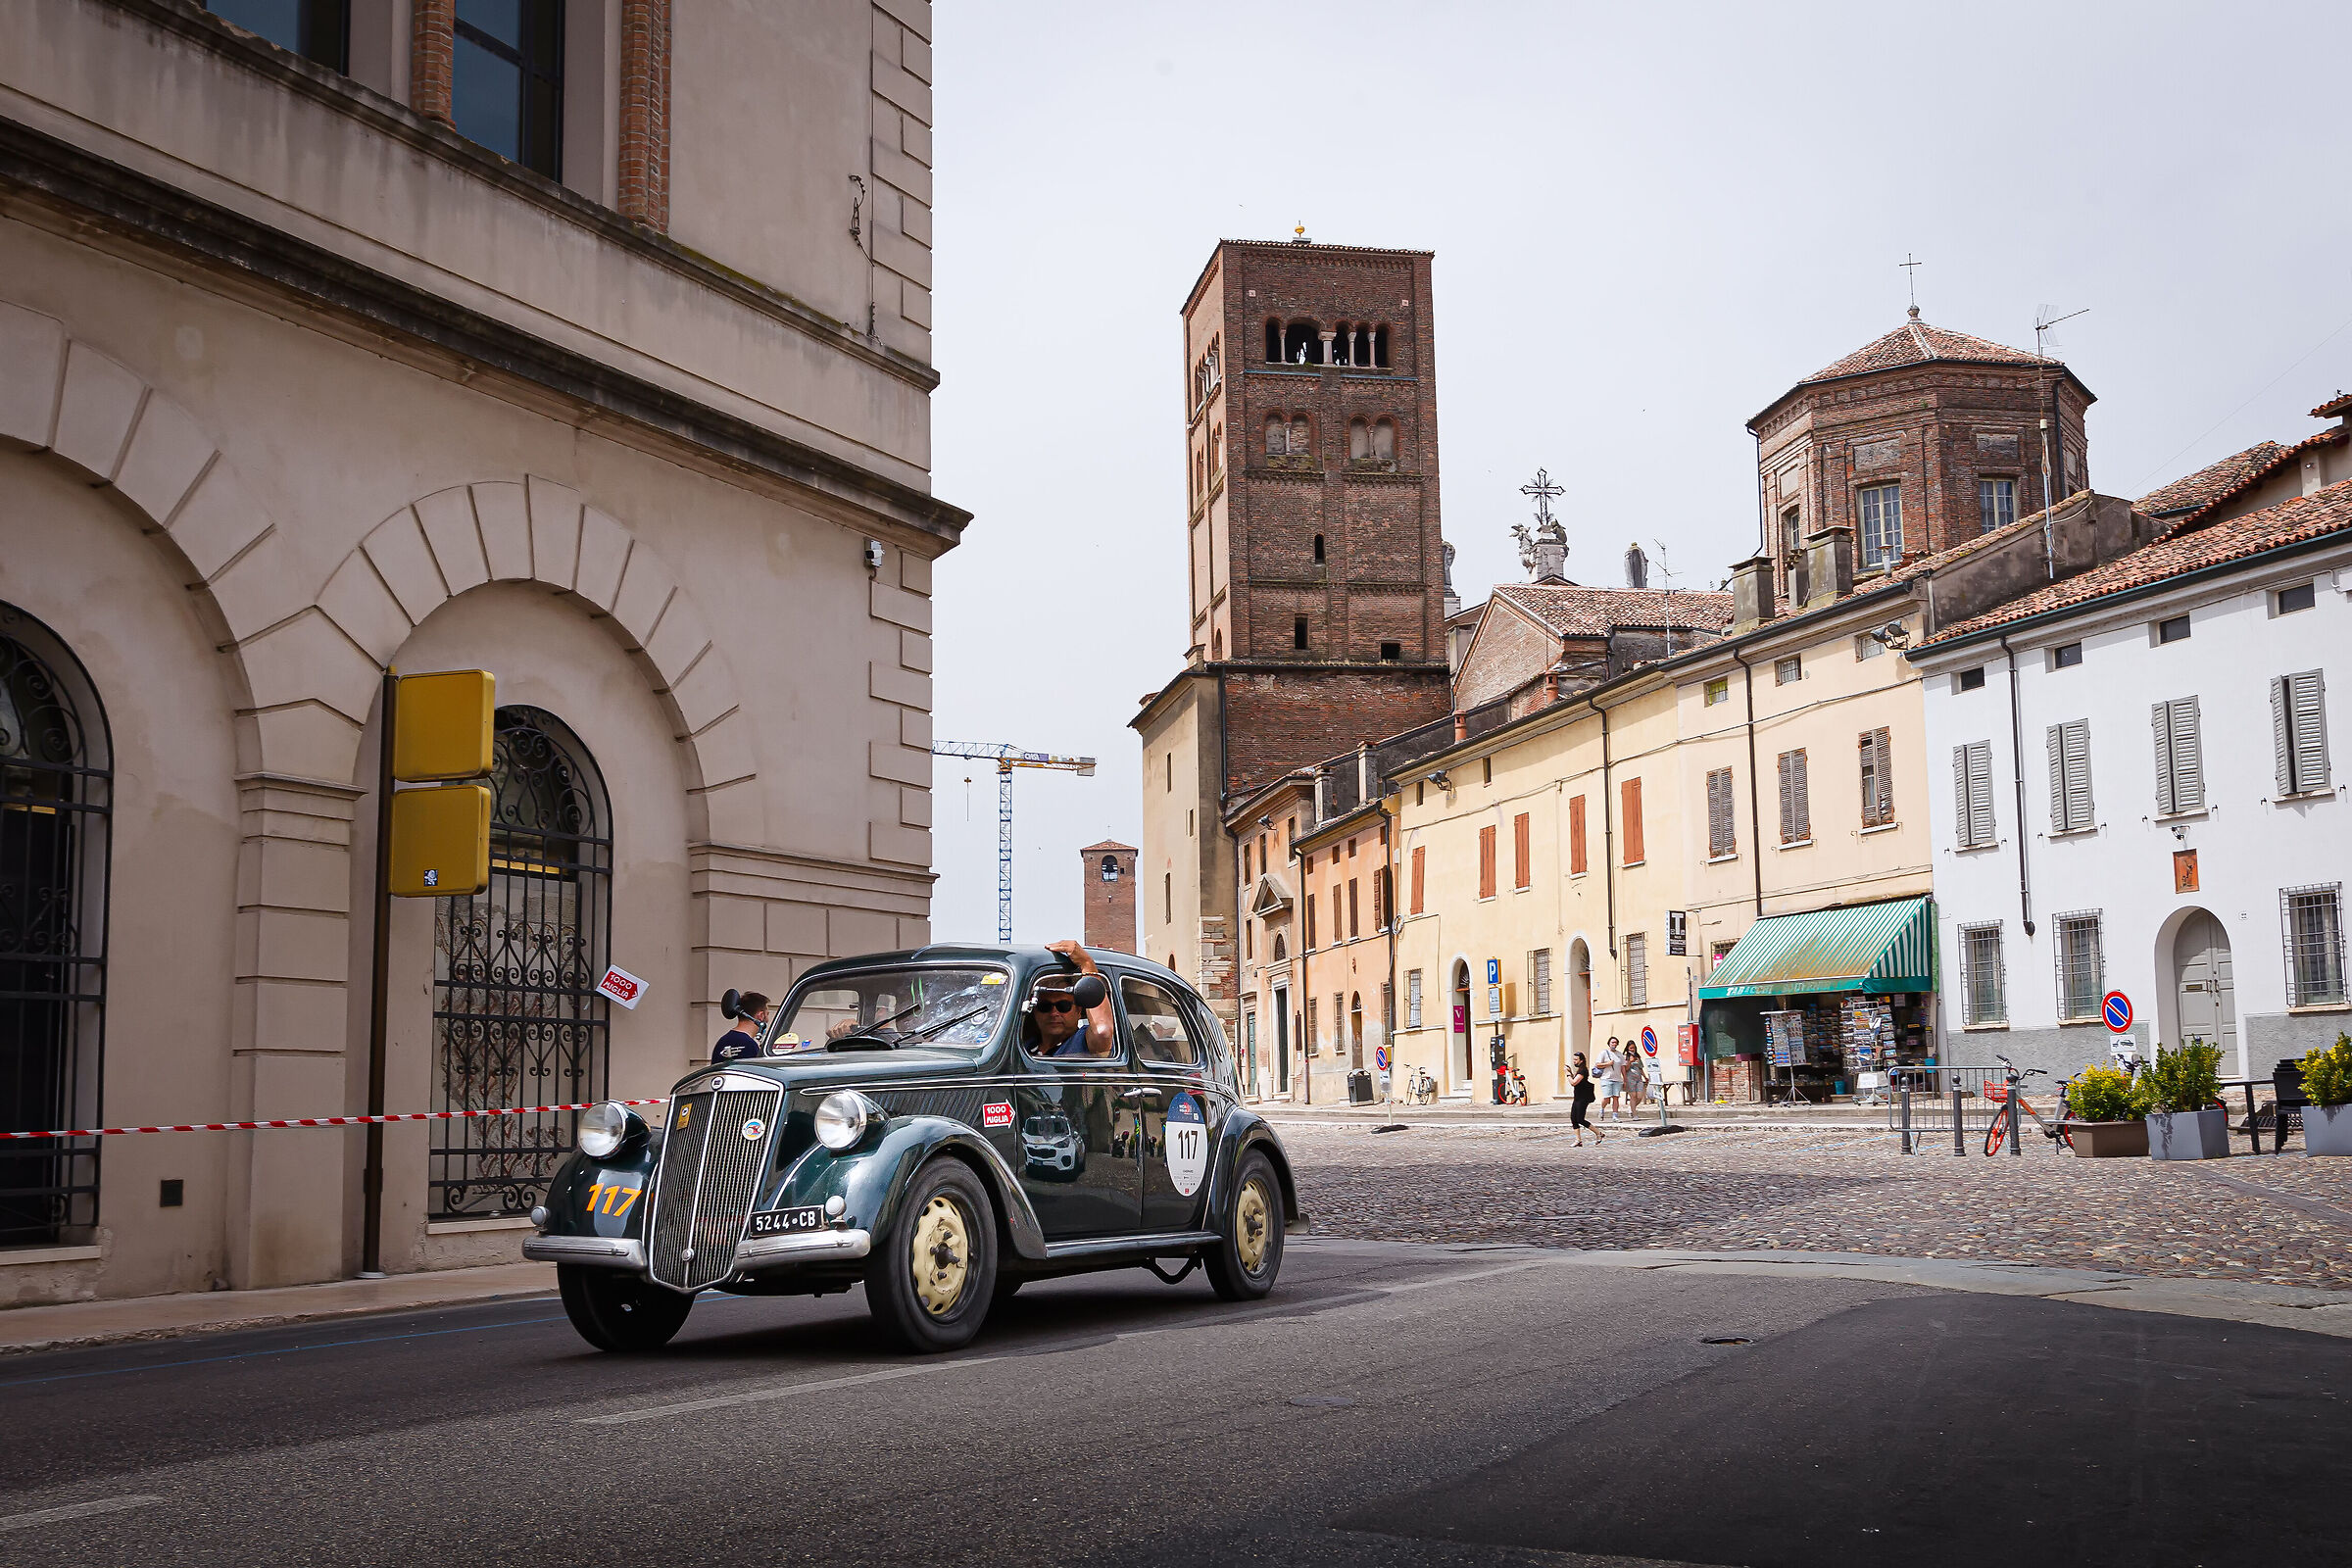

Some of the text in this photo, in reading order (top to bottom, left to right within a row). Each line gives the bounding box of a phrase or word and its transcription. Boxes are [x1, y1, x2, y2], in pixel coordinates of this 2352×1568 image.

[1671, 912, 1684, 935] T
[1489, 961, 1496, 982] P
[602, 981, 629, 999] MIGLIA
[610, 974, 632, 990] 1000
[987, 1105, 1006, 1114] 1000
[987, 1115, 1008, 1124] MIGLIA
[1178, 1130, 1198, 1159] 117
[586, 1182, 643, 1216] 117
